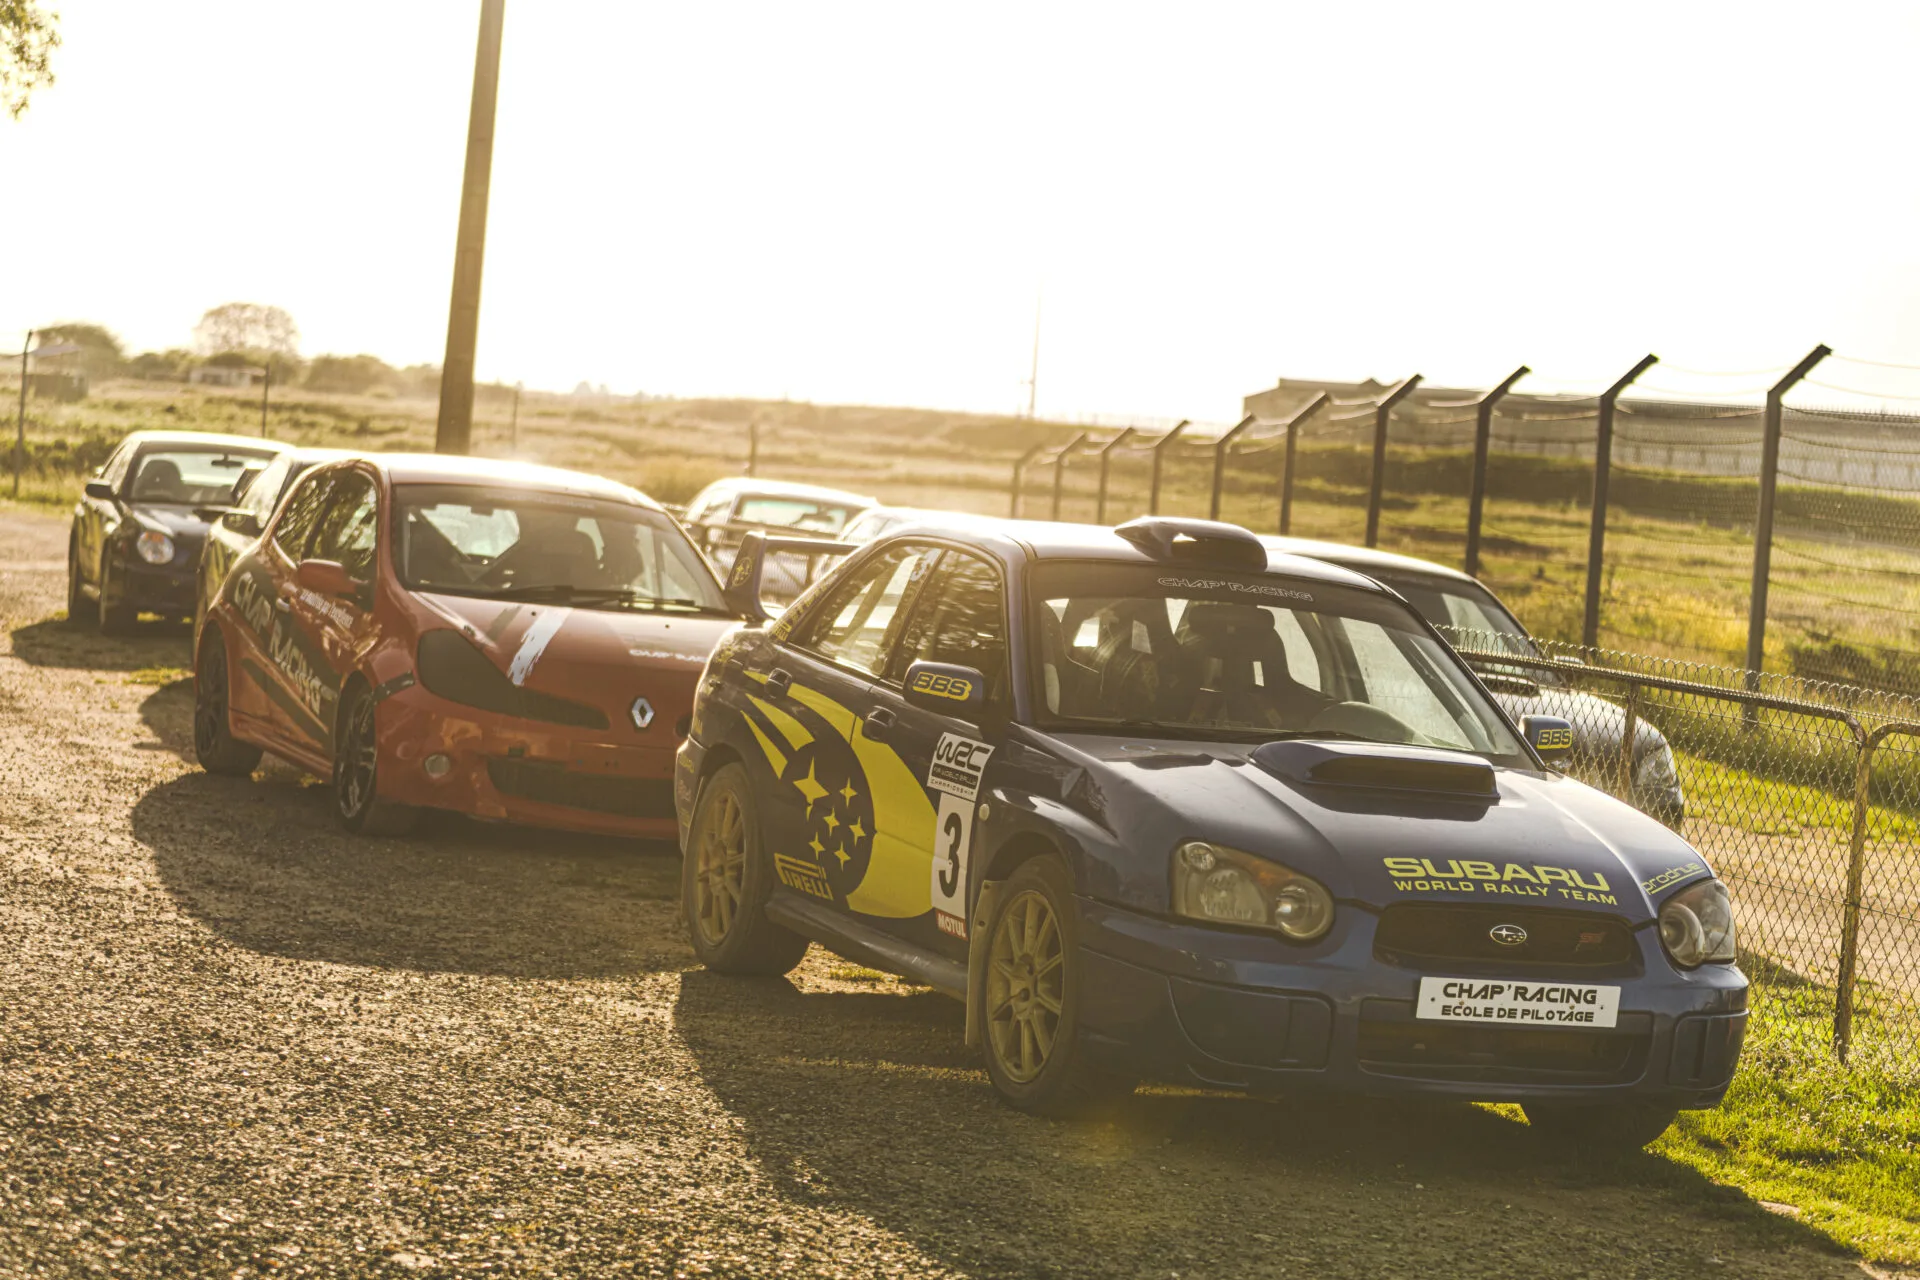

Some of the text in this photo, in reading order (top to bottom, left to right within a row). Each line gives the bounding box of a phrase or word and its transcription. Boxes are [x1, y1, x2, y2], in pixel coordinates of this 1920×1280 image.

[912, 671, 972, 701] BBS
[1536, 728, 1572, 749] BBS
[936, 735, 990, 773] WRC
[938, 812, 962, 898] 3
[774, 852, 834, 901] PIRELLI
[1383, 857, 1610, 892] SUBARU
[1393, 880, 1618, 906] WORLD RALLY TEAM
[938, 913, 966, 938] MOTUL
[1441, 1005, 1594, 1022] ECOLE DE PILOTAGE
